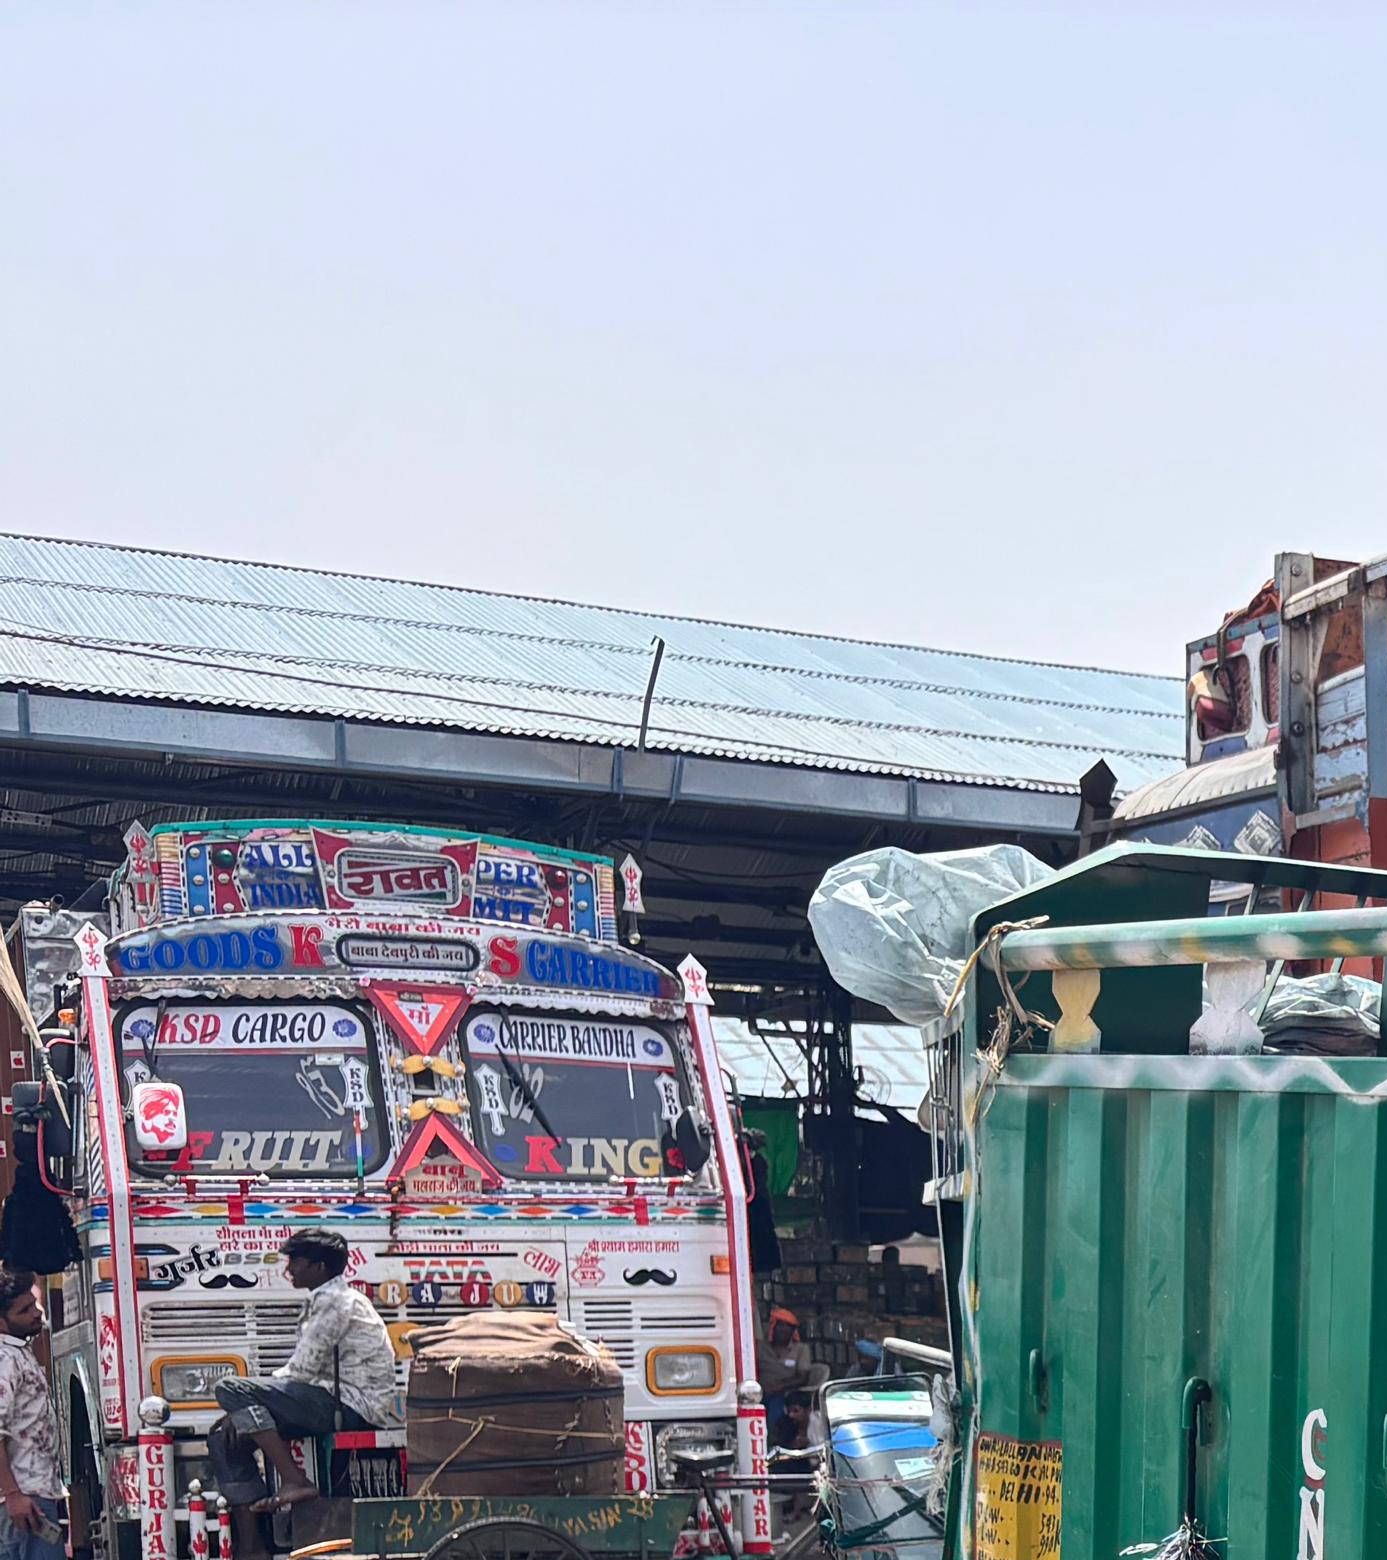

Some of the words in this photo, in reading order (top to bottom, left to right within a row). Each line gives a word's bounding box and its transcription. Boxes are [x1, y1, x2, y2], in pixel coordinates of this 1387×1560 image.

[343, 864, 449, 896] रावत
[476, 859, 538, 888] PER
[119, 924, 284, 972] GOODS
[288, 924, 326, 968] K
[350, 944, 379, 959] बाबा
[422, 944, 440, 961] की
[487, 935, 523, 978] S
[527, 939, 661, 998] CARRIER
[158, 1012, 221, 1044] KSD
[231, 1012, 326, 1043] CARGO
[571, 1024, 637, 1059] BANDHA
[170, 1130, 343, 1171] FRUIT
[524, 1136, 662, 1177] KING
[223, 1252, 281, 1266] BS6
[403, 1259, 493, 1282] TATA
